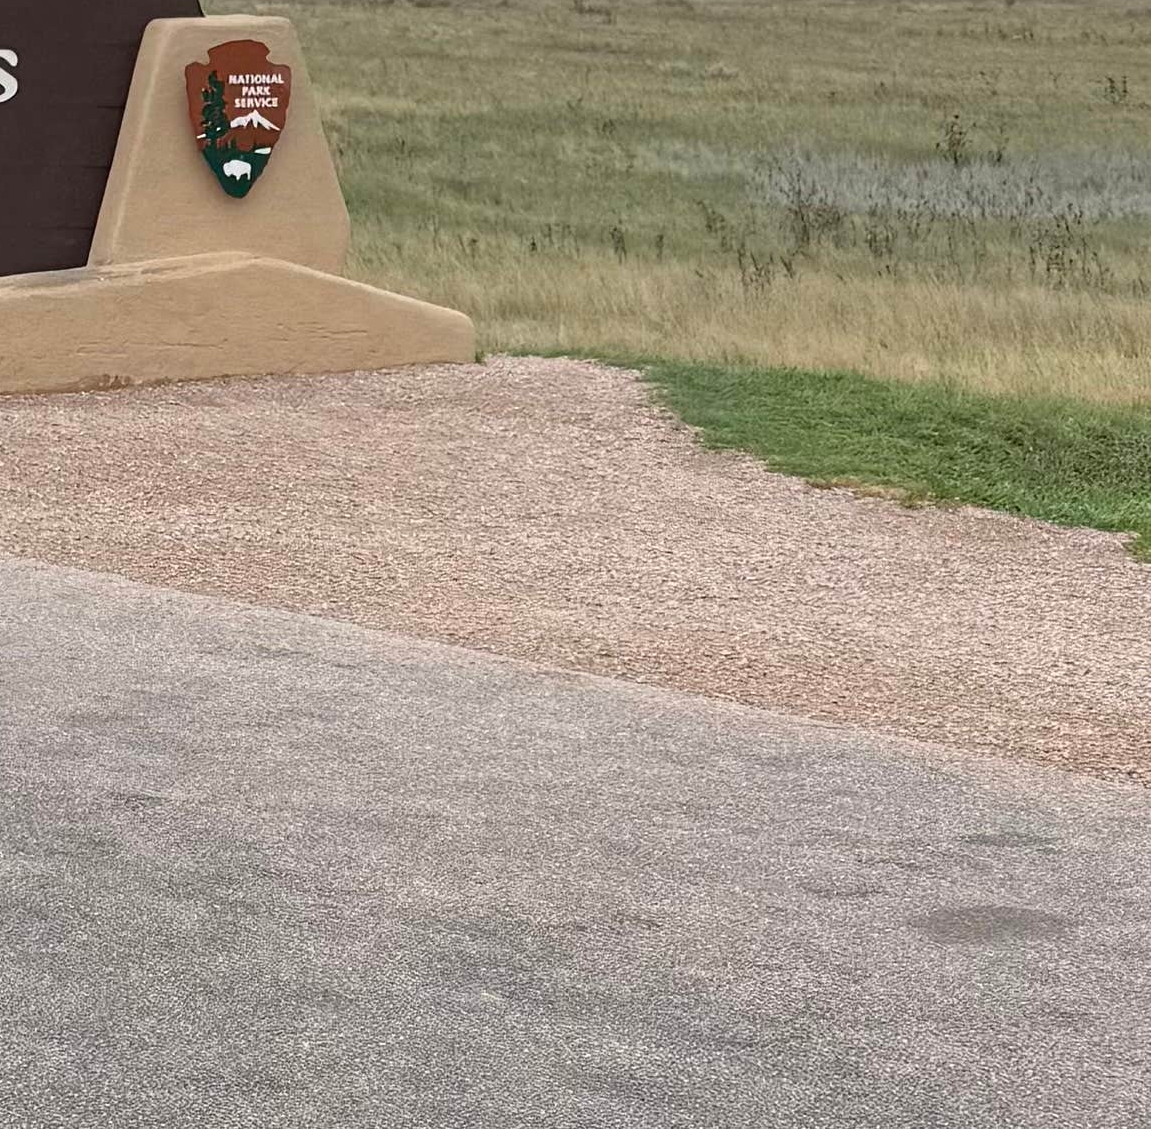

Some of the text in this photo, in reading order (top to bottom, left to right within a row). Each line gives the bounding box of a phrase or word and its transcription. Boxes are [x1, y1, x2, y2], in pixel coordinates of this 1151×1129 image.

[228, 73, 285, 84] NATIONAL
[241, 85, 271, 96] PARK
[234, 97, 279, 108] SERVICE
